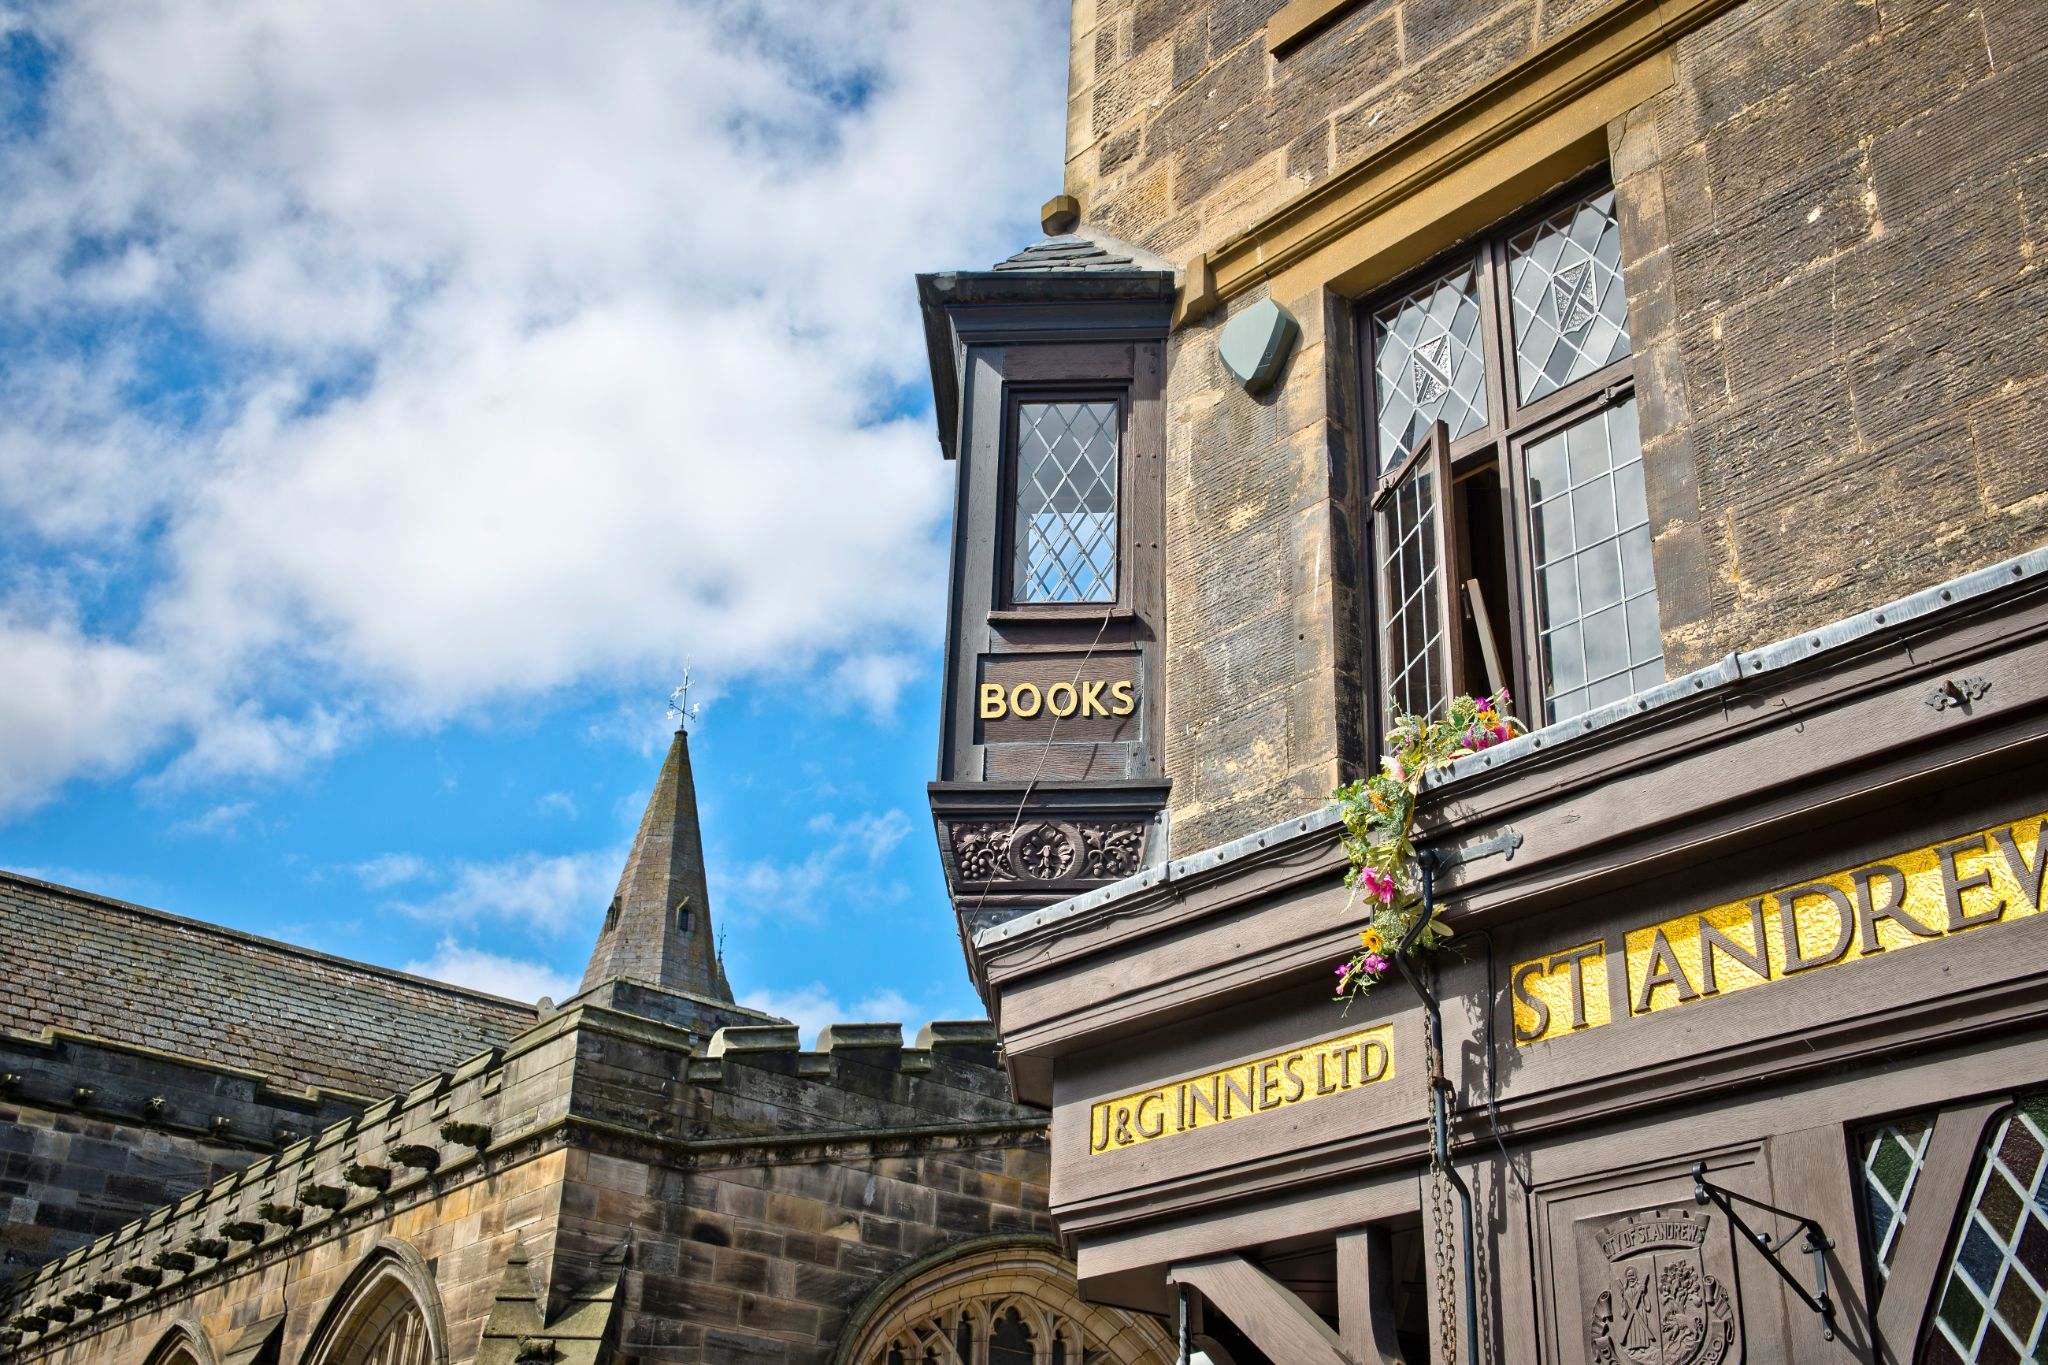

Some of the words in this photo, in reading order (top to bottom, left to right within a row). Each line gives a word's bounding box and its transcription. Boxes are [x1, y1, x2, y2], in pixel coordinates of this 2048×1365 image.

[980, 680, 1135, 719] BOOKS
[1515, 941, 1603, 1042] ST
[1092, 1090, 1165, 1151] J&G
[1176, 1053, 1304, 1132] INNES
[1316, 1038, 1390, 1096] LTD
